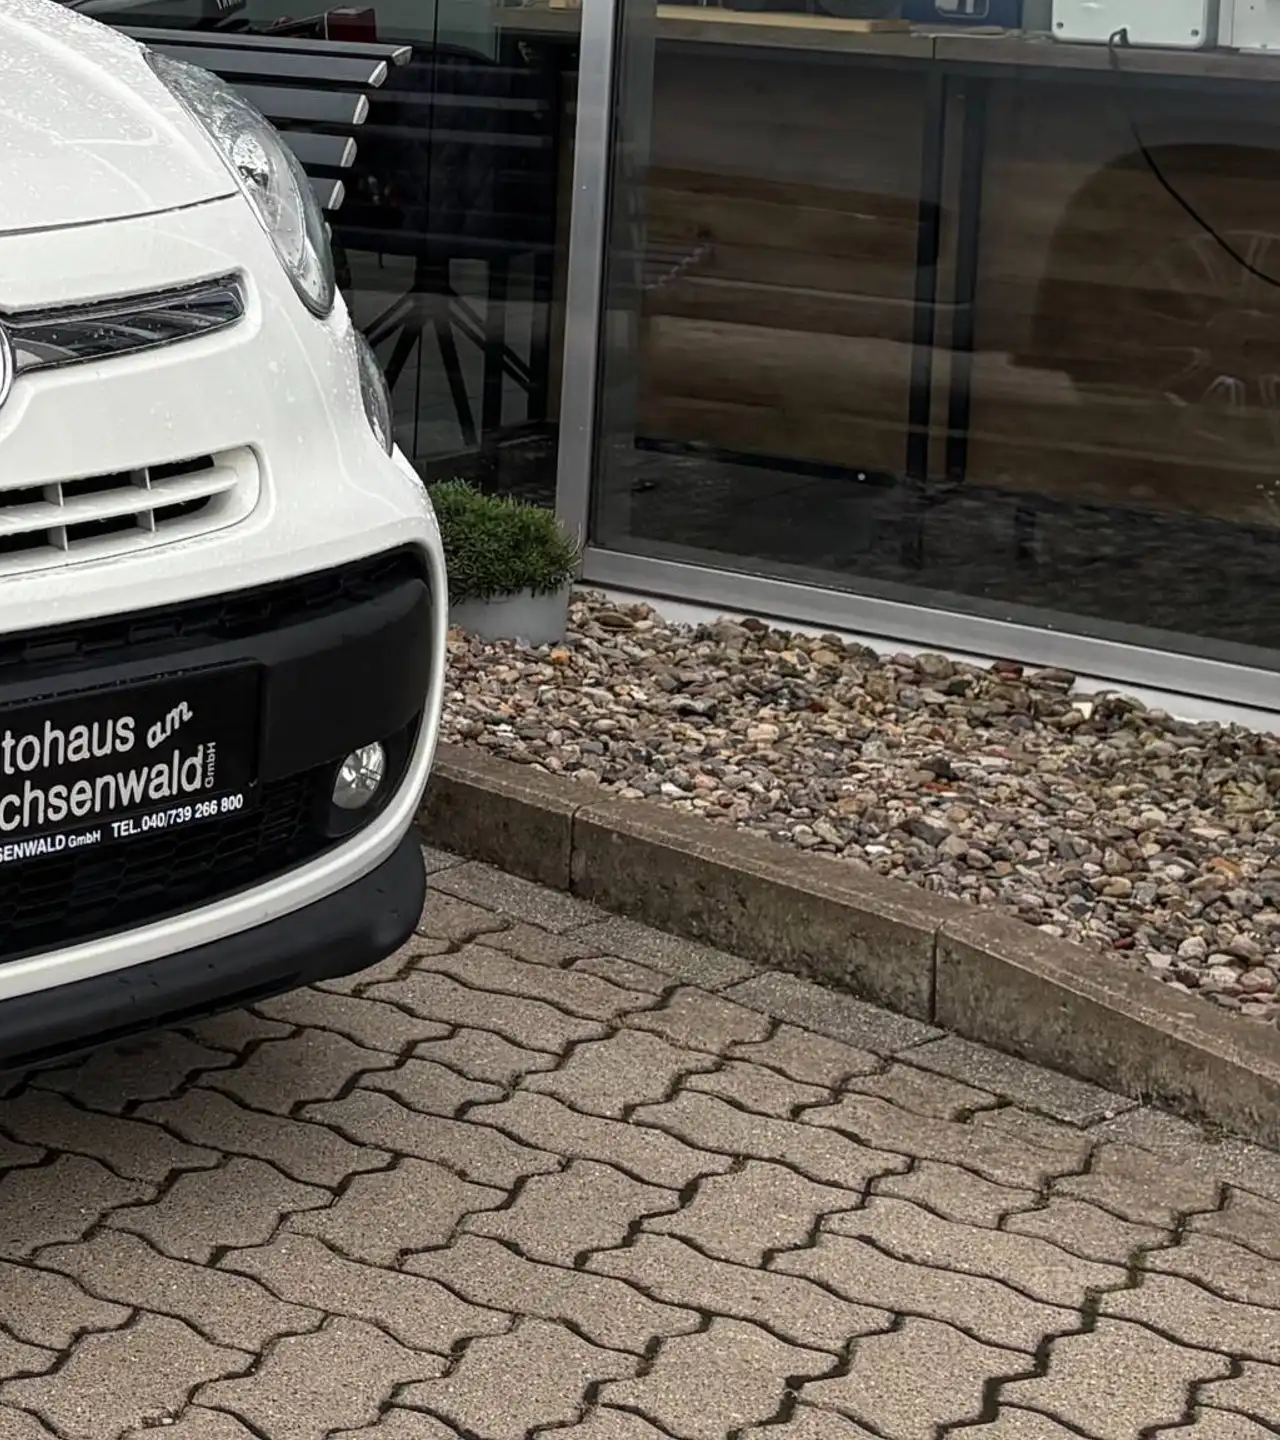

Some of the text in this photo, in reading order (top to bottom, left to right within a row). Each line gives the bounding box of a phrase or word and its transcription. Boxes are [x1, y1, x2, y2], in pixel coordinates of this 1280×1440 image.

[146, 700, 194, 750] am
[203, 741, 217, 789] GmbH
[67, 829, 102, 849] GmbH
[194, 800, 219, 820] 266
[220, 793, 245, 813] 800
